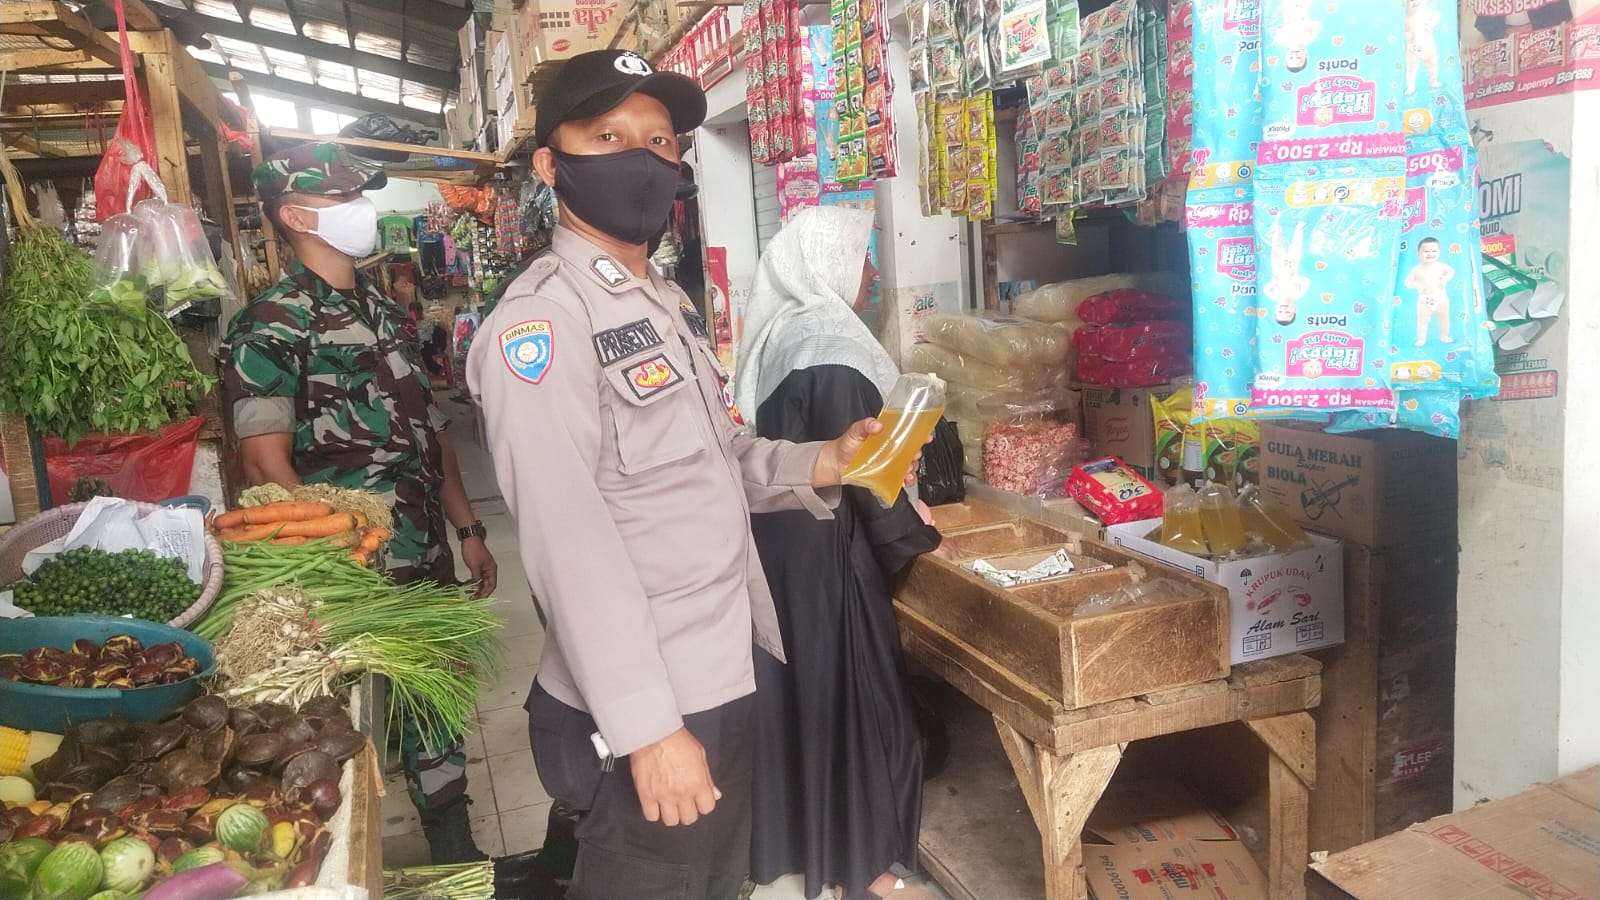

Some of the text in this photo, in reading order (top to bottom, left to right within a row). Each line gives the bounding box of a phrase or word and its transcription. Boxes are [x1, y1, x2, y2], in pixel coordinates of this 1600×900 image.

[1319, 59, 1358, 72] Pants
[1334, 78, 1360, 89] Body
[1264, 142, 1331, 161] 2.500,-
[1334, 138, 1363, 156] Rp.
[1307, 315, 1347, 328] Pants
[504, 323, 546, 342] BINMAS
[1324, 333, 1349, 345] Body
[1289, 345, 1361, 366] Happy!
[1326, 357, 1359, 369] Baby
[1254, 391, 1320, 407] 2.500,-
[1324, 391, 1351, 407] Rp.
[1267, 440, 1362, 469] GULA MERAH
[1266, 465, 1308, 487] BIOLA
[1245, 569, 1285, 598] KRUPUK
[1246, 618, 1285, 635] Alam
[1289, 610, 1320, 626] Sari
